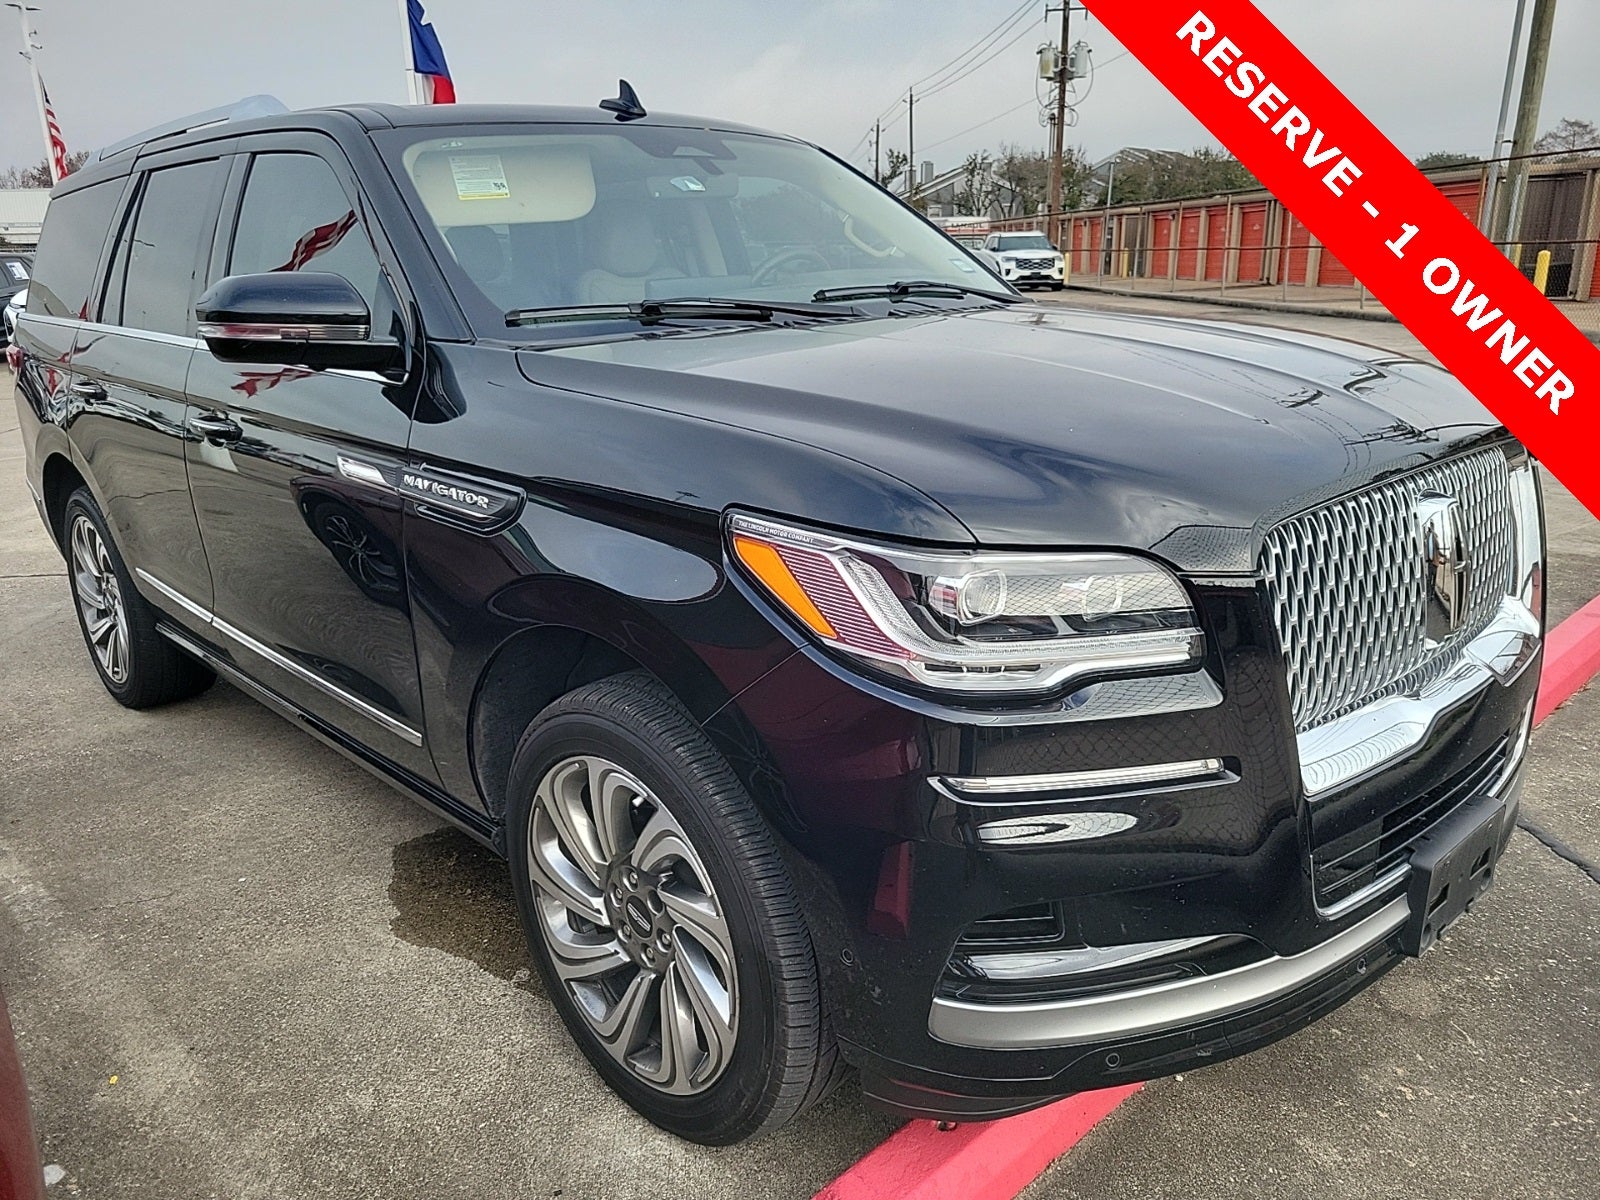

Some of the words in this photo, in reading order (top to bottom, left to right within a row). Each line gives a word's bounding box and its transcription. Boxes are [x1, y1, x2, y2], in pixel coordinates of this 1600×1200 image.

[404, 474, 488, 508] NAVIGATOR
[738, 520, 748, 528] THE
[748, 522, 769, 533] LINCOLN
[769, 527, 787, 537] MOTOR
[788, 533, 814, 543] COMPANY
